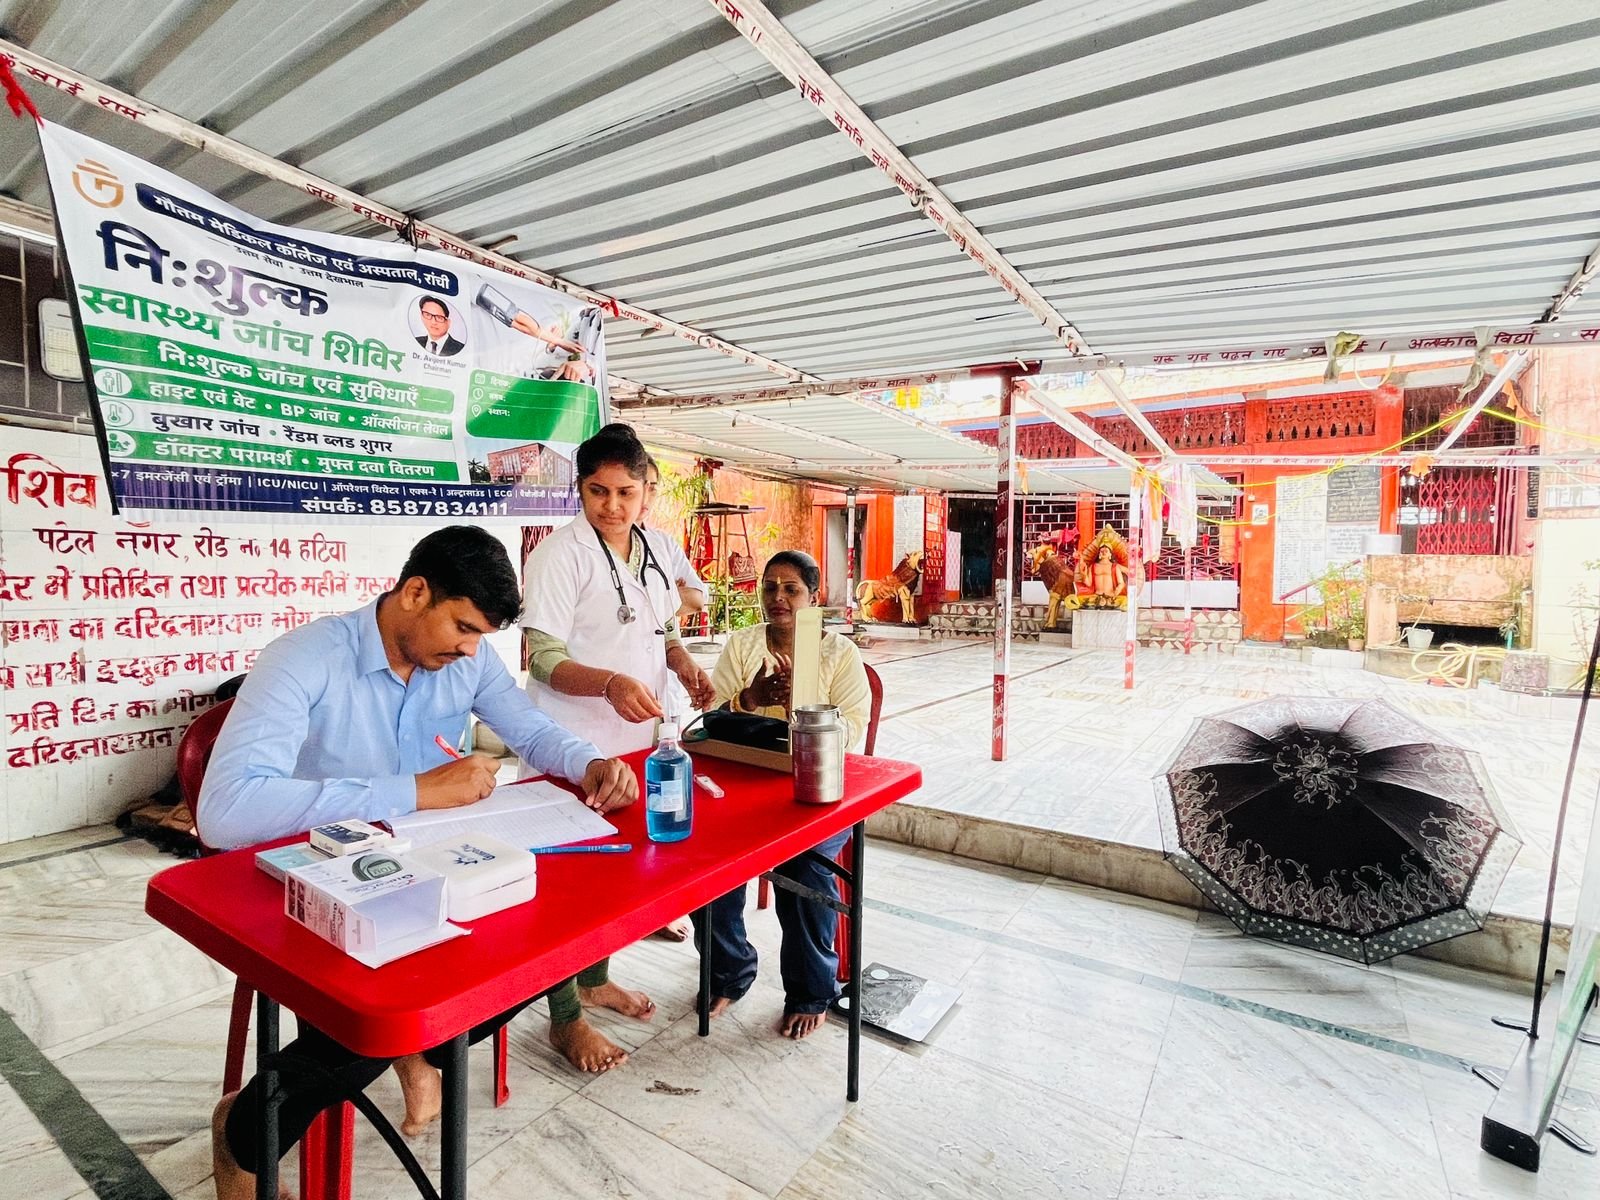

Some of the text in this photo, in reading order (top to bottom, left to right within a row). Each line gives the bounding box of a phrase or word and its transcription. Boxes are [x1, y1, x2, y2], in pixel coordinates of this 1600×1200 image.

[98, 95, 146, 119] राम
[153, 194, 205, 226] गौतम
[275, 239, 327, 267] कॉलेज
[331, 257, 354, 273] एवं
[358, 264, 422, 287] अस्पताल,
[423, 269, 450, 292] रांची
[263, 254, 284, 269] सेवा
[325, 270, 364, 289] देखभाल
[78, 284, 407, 374] स्वास्थ्य जांच शिविर
[412, 352, 422, 361] Dr.
[424, 362, 452, 374] Chairman
[257, 366, 307, 388] जांच
[311, 375, 344, 395] एवं
[348, 380, 419, 407] सुविधाएँ
[148, 381, 449, 436] हाइट एवं वेट BP जांच ऑक्सीजन लेवल
[151, 412, 393, 455] बुखार जांच रैंडम ब्लड शुगर
[152, 437, 435, 477] डॉक्टर परामर्श मुफ्त दवा वितरण
[135, 470, 190, 484] इमरजेंसी
[194, 473, 212, 485] एवं
[215, 473, 242, 487] ट्रॉमा
[257, 477, 319, 490] ICU/NICU
[331, 480, 369, 493] ऑपरेशन
[494, 489, 513, 498] ECG
[301, 496, 509, 517] संपर्क: 8587834111
[33, 521, 98, 555] पटेल
[193, 527, 230, 558] रोड
[269, 538, 292, 560] 14
[80, 566, 174, 601] प्रतिदिन
[180, 575, 228, 599] तथा
[235, 569, 298, 599] प्रत्येक
[69, 617, 105, 641] का
[6, 700, 62, 736] प्रति
[126, 699, 158, 720] का
